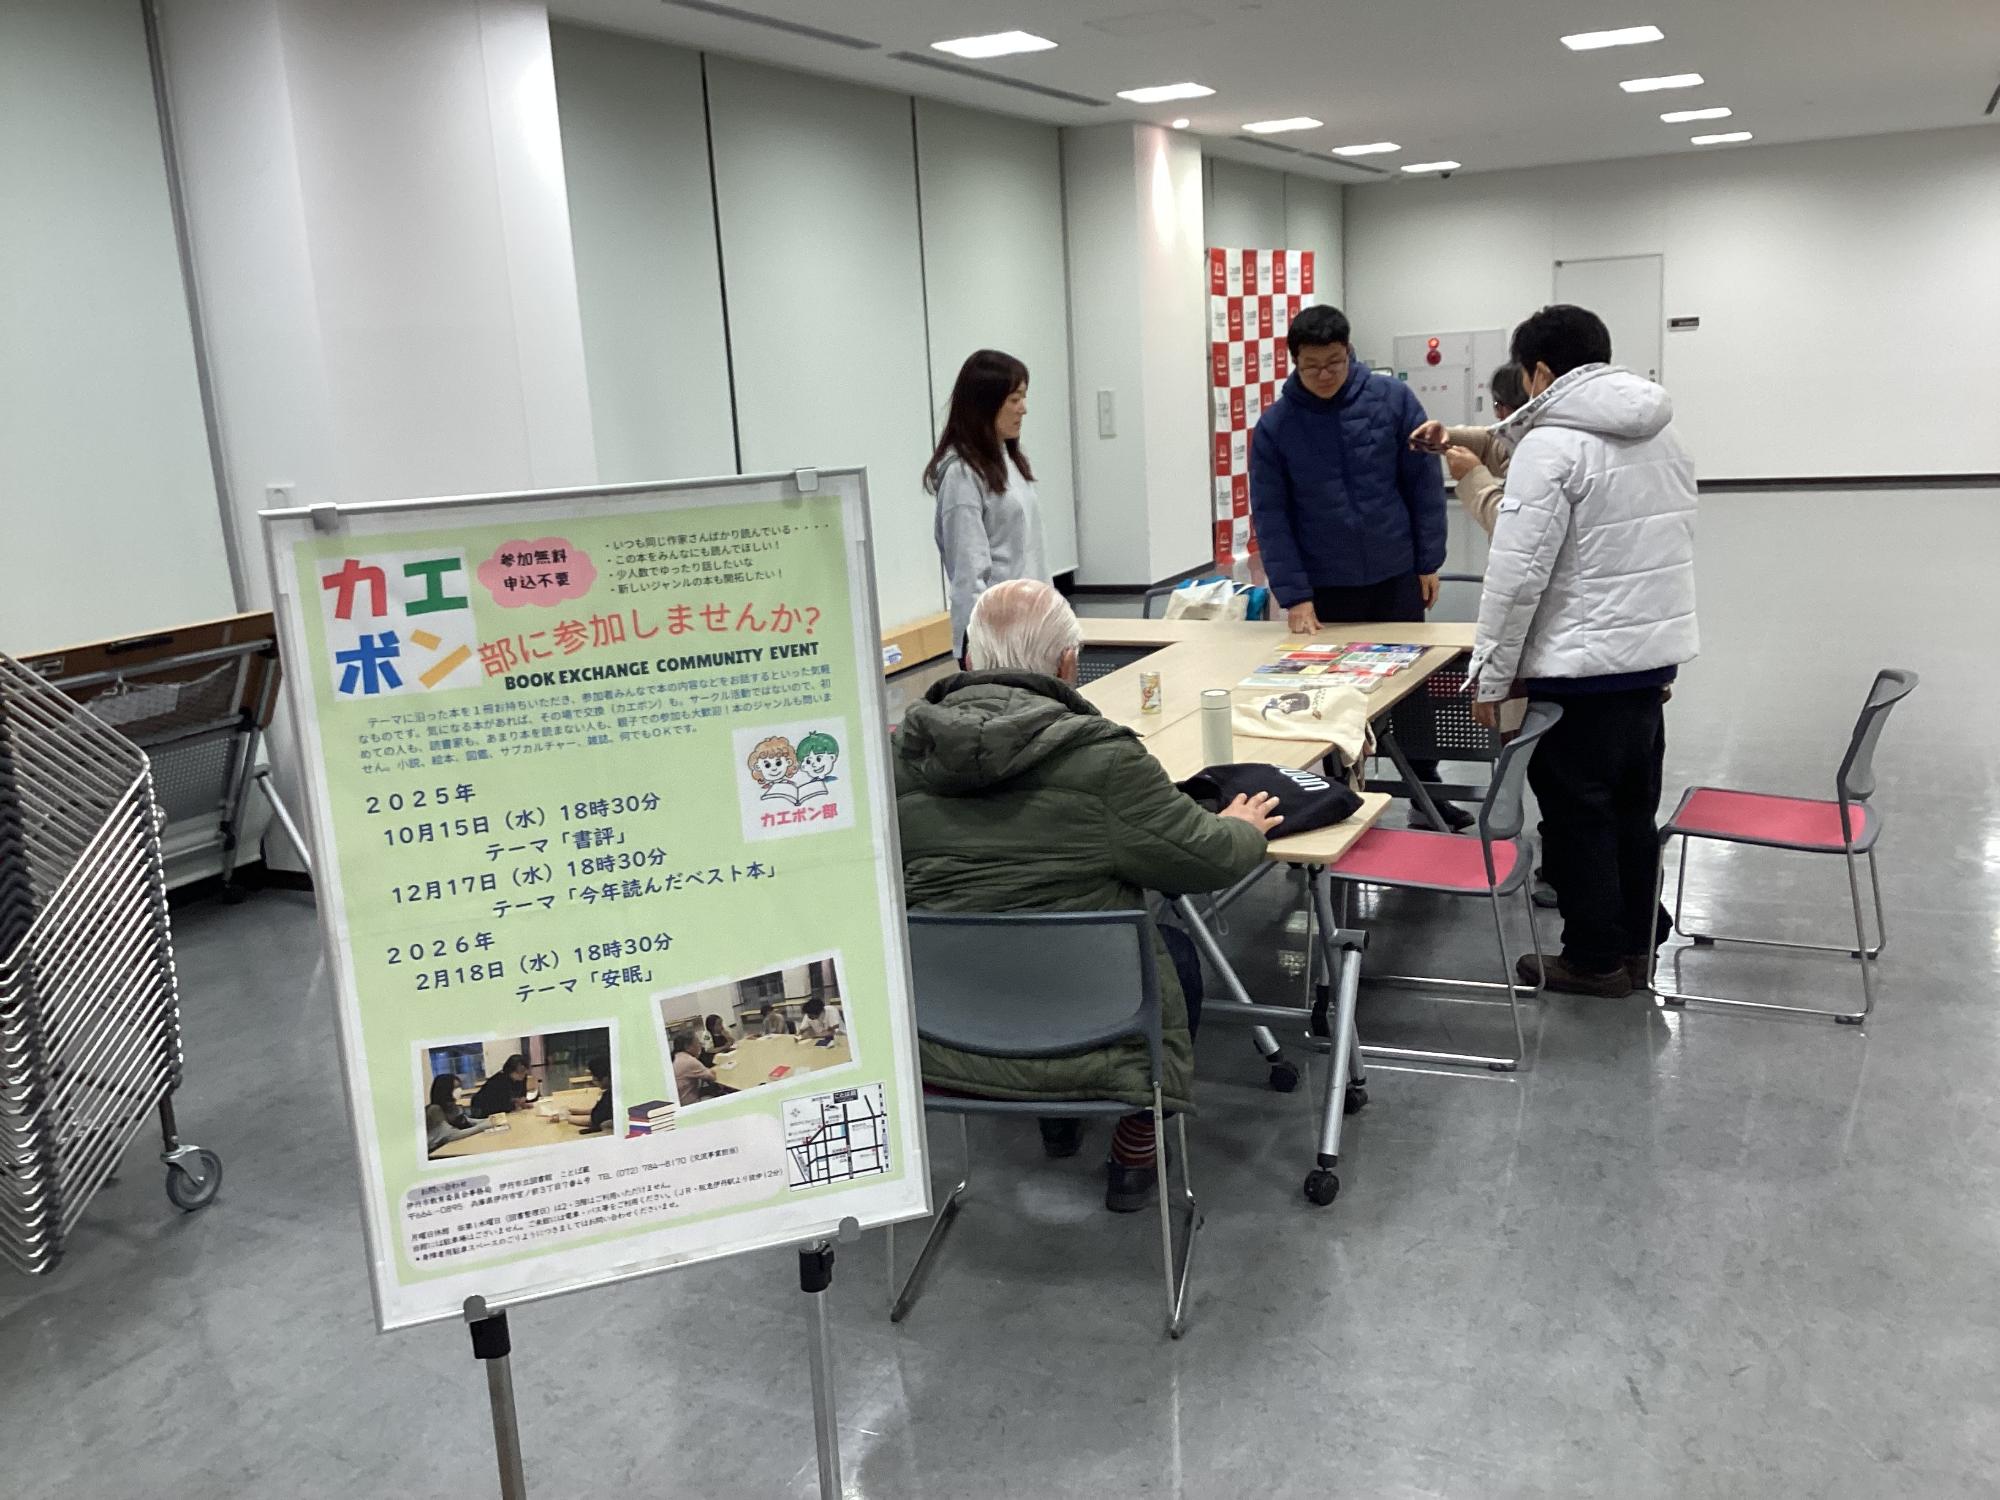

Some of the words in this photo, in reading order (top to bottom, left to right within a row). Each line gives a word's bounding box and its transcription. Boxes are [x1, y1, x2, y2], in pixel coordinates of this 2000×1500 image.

[501, 548, 567, 567] 参加無料
[504, 571, 571, 592] 申込不要
[477, 601, 821, 678] 部に参加しませんか?
[504, 670, 555, 690] BOOK
[559, 660, 650, 685] EXCHANGE
[656, 647, 763, 673] COMMUNITY
[770, 641, 819, 661] EVENT
[366, 784, 476, 814] 2025年
[760, 803, 838, 827] カエボン部
[486, 827, 626, 862] テーマ「書評」
[493, 861, 776, 918] テーマ「今年読んだベスト本」
[387, 931, 496, 965] 2026年
[515, 965, 653, 1003] テーマ「安眠」
